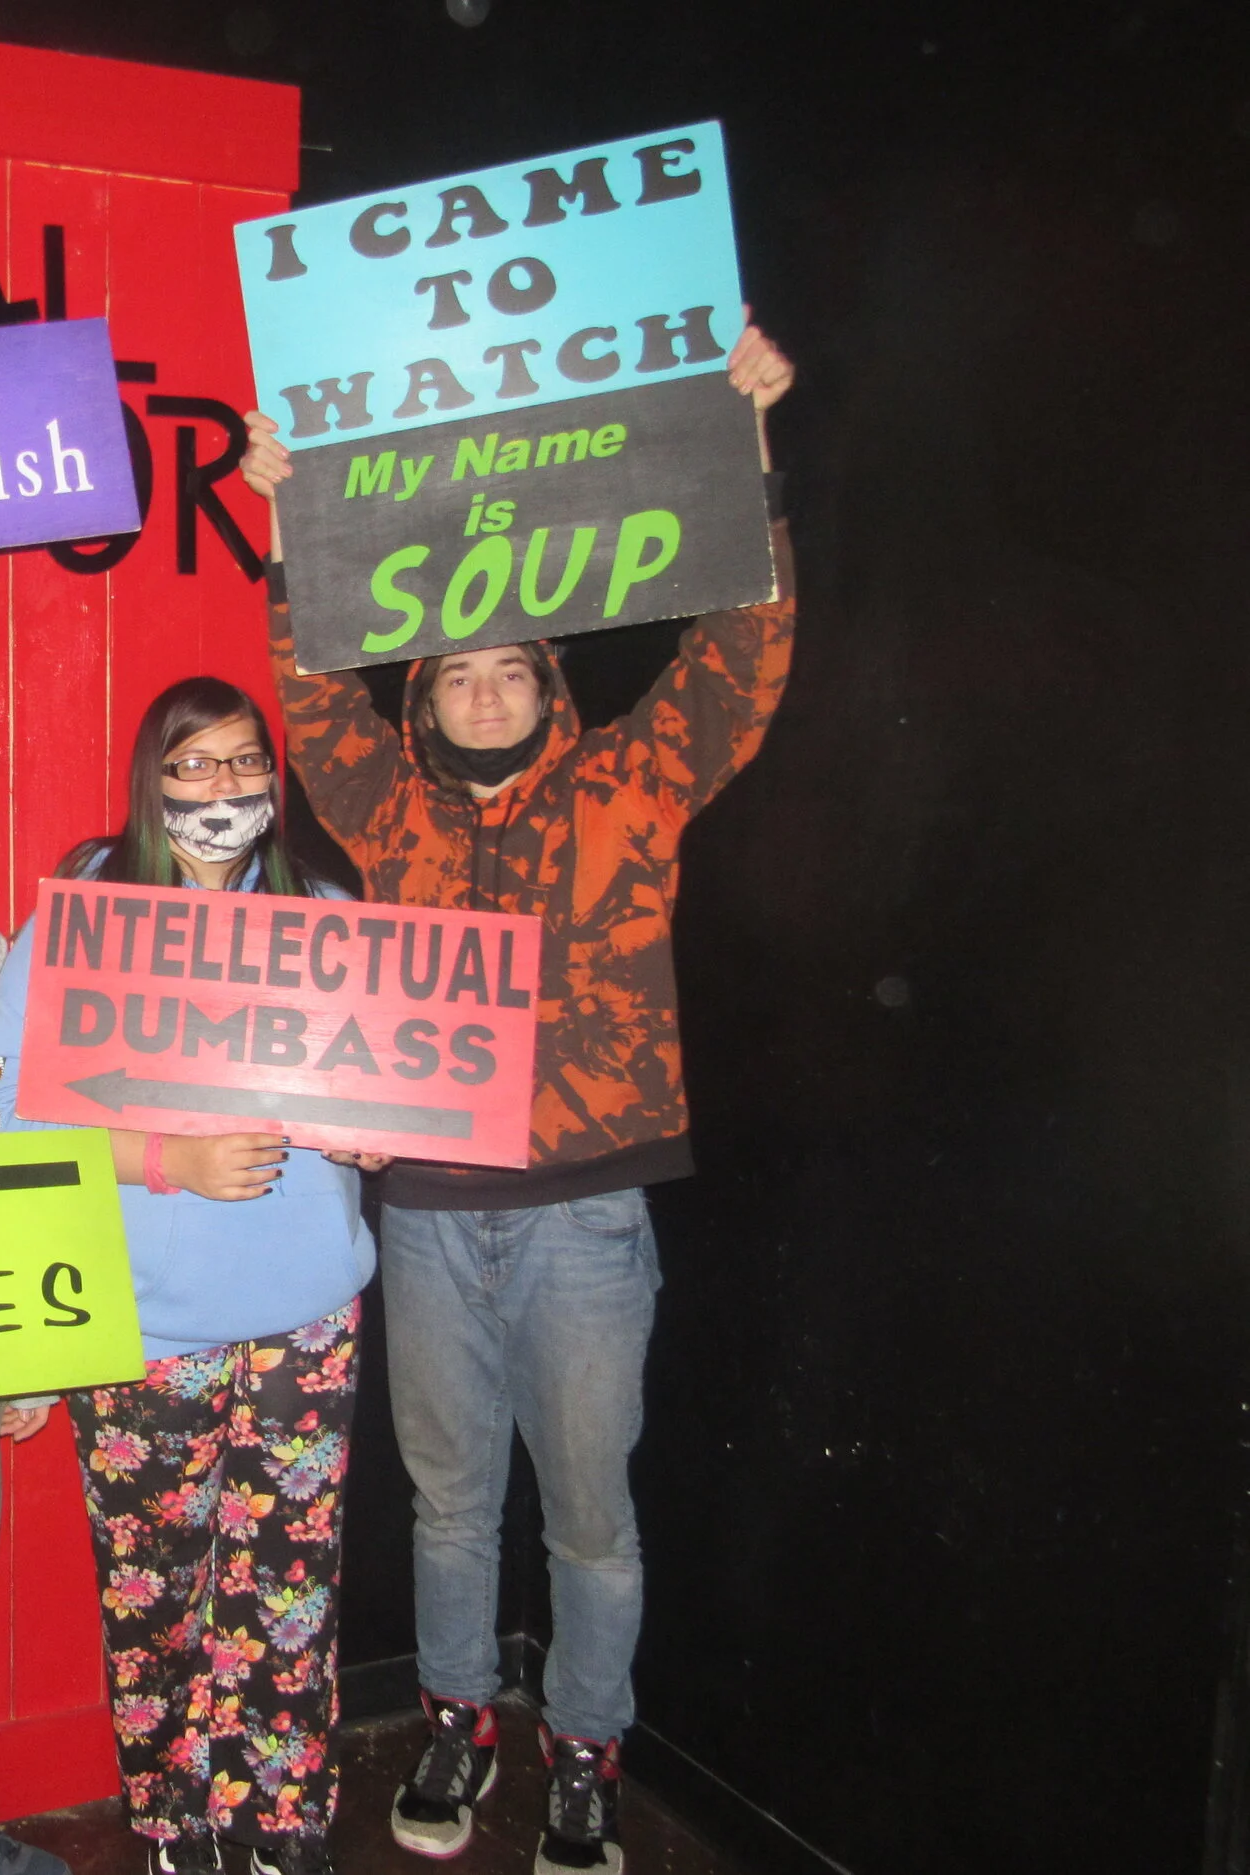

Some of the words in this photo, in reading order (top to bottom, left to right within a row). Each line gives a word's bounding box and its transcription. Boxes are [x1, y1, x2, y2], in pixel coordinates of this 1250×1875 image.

[264, 223, 308, 282] I
[349, 137, 703, 259] CAME
[413, 256, 557, 331] TO
[278, 304, 726, 439] WATCH
[343, 450, 434, 502] My
[452, 422, 627, 482] Name
[463, 492, 517, 537] is
[360, 509, 681, 654] SOUP
[45, 891, 531, 1010] INTELLECTUAL
[59, 987, 497, 1086] DUMBASS
